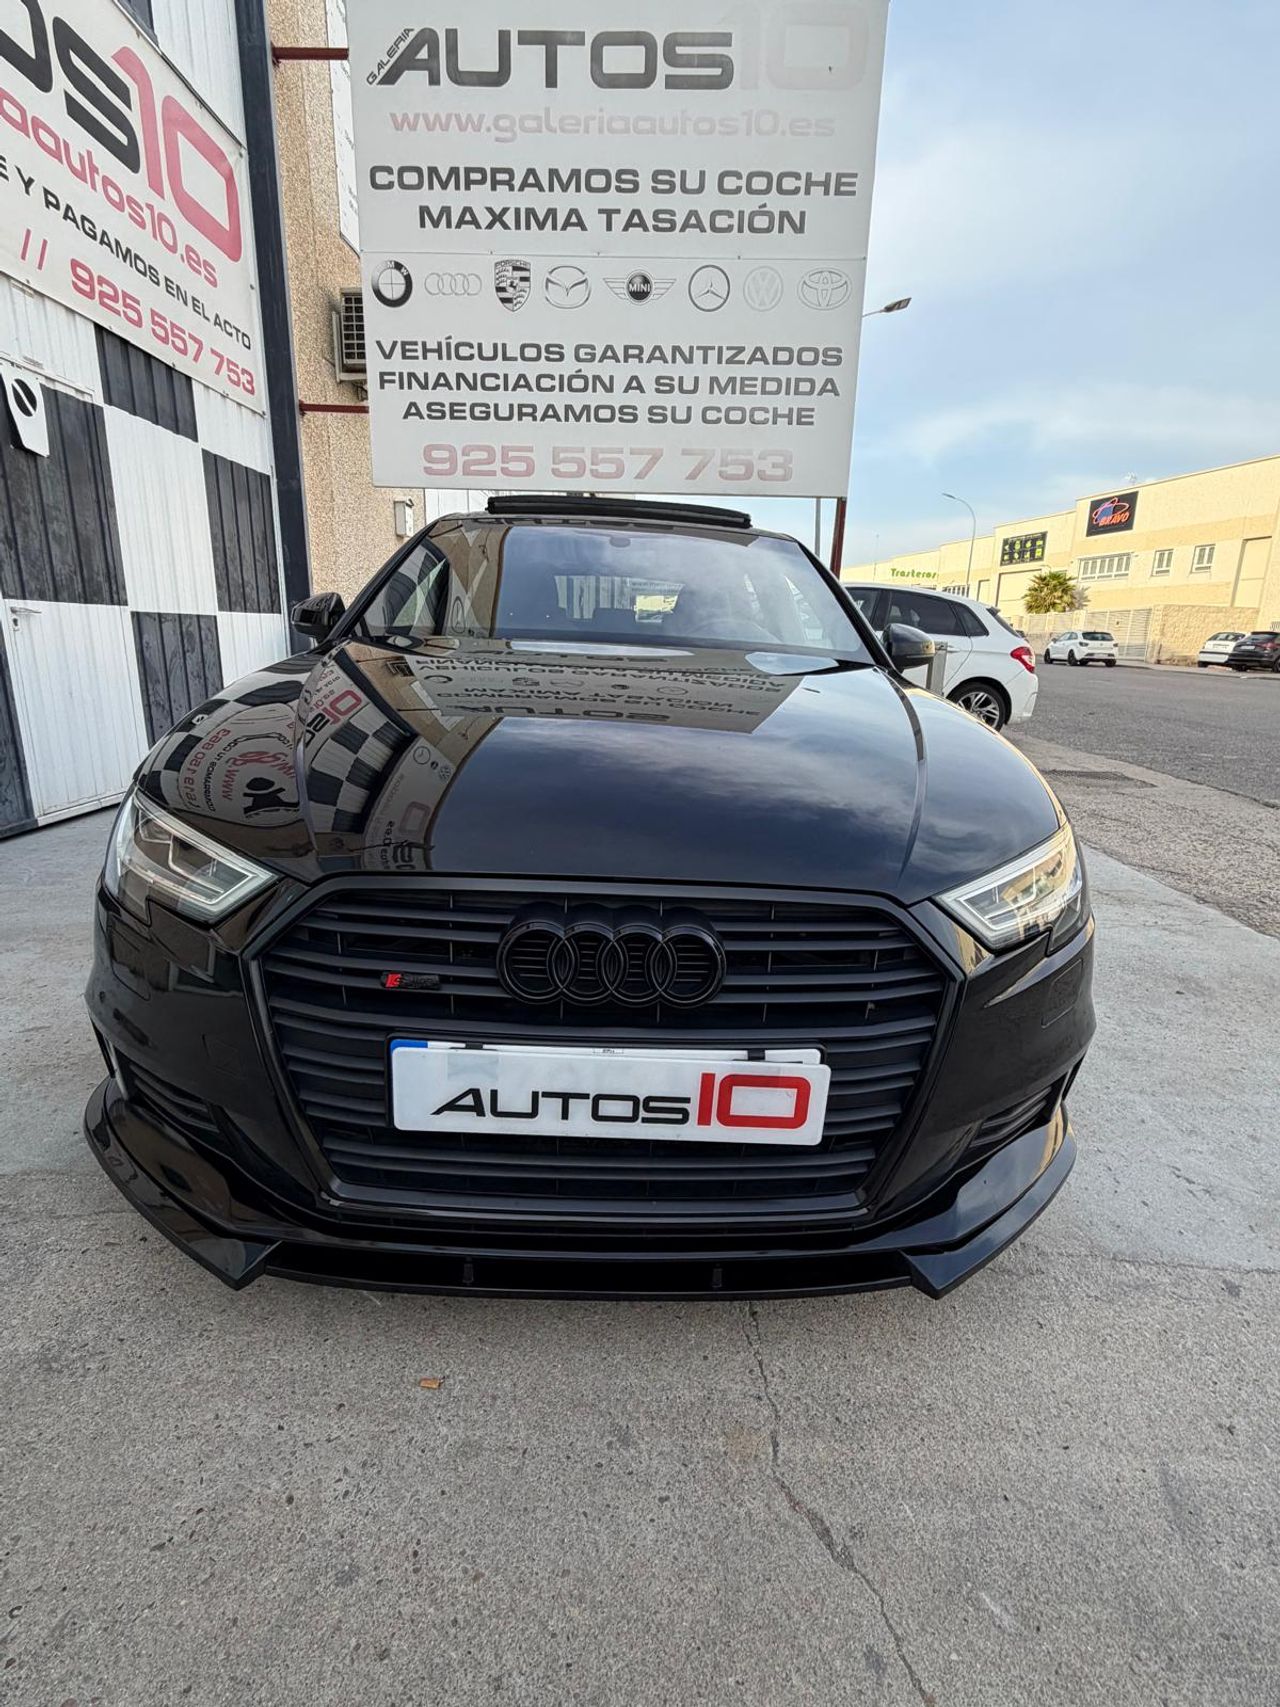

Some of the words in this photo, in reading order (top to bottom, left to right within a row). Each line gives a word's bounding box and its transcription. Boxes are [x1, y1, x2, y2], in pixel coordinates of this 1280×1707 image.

[366, 27, 415, 86] GALERIA
[389, 107, 835, 143] www.galeriaautos10.es
[369, 164, 640, 194] COMPRAMOS
[651, 168, 706, 195] SU
[716, 170, 859, 197] COCHE
[418, 205, 588, 232] MAXIMA
[598, 202, 807, 235] TASACIÓN
[15, 165, 35, 196] Y
[42, 186, 160, 286] PAGAMOS
[164, 274, 189, 307] EN
[191, 296, 210, 323] EL
[213, 313, 251, 350] ACTO
[628, 282, 651, 293] MINI
[70, 257, 144, 329] 925
[151, 306, 204, 364] 557
[210, 347, 255, 396] 753
[376, 336, 565, 363] VEHÍCULOS
[573, 344, 843, 367] GARANTIZADOS
[378, 368, 615, 394] FINANCIACIÓN
[622, 375, 647, 394] A
[654, 375, 700, 396] SU
[708, 376, 840, 397] MEDIDA
[402, 401, 639, 424] ASEGURAMOS
[647, 405, 693, 425] SU
[701, 406, 815, 426] COCHE
[423, 443, 535, 477] 925
[551, 445, 665, 480] 557
[680, 447, 793, 482] 753
[891, 568, 937, 579] Trasteros
[430, 1072, 812, 1130] AUTOS10
